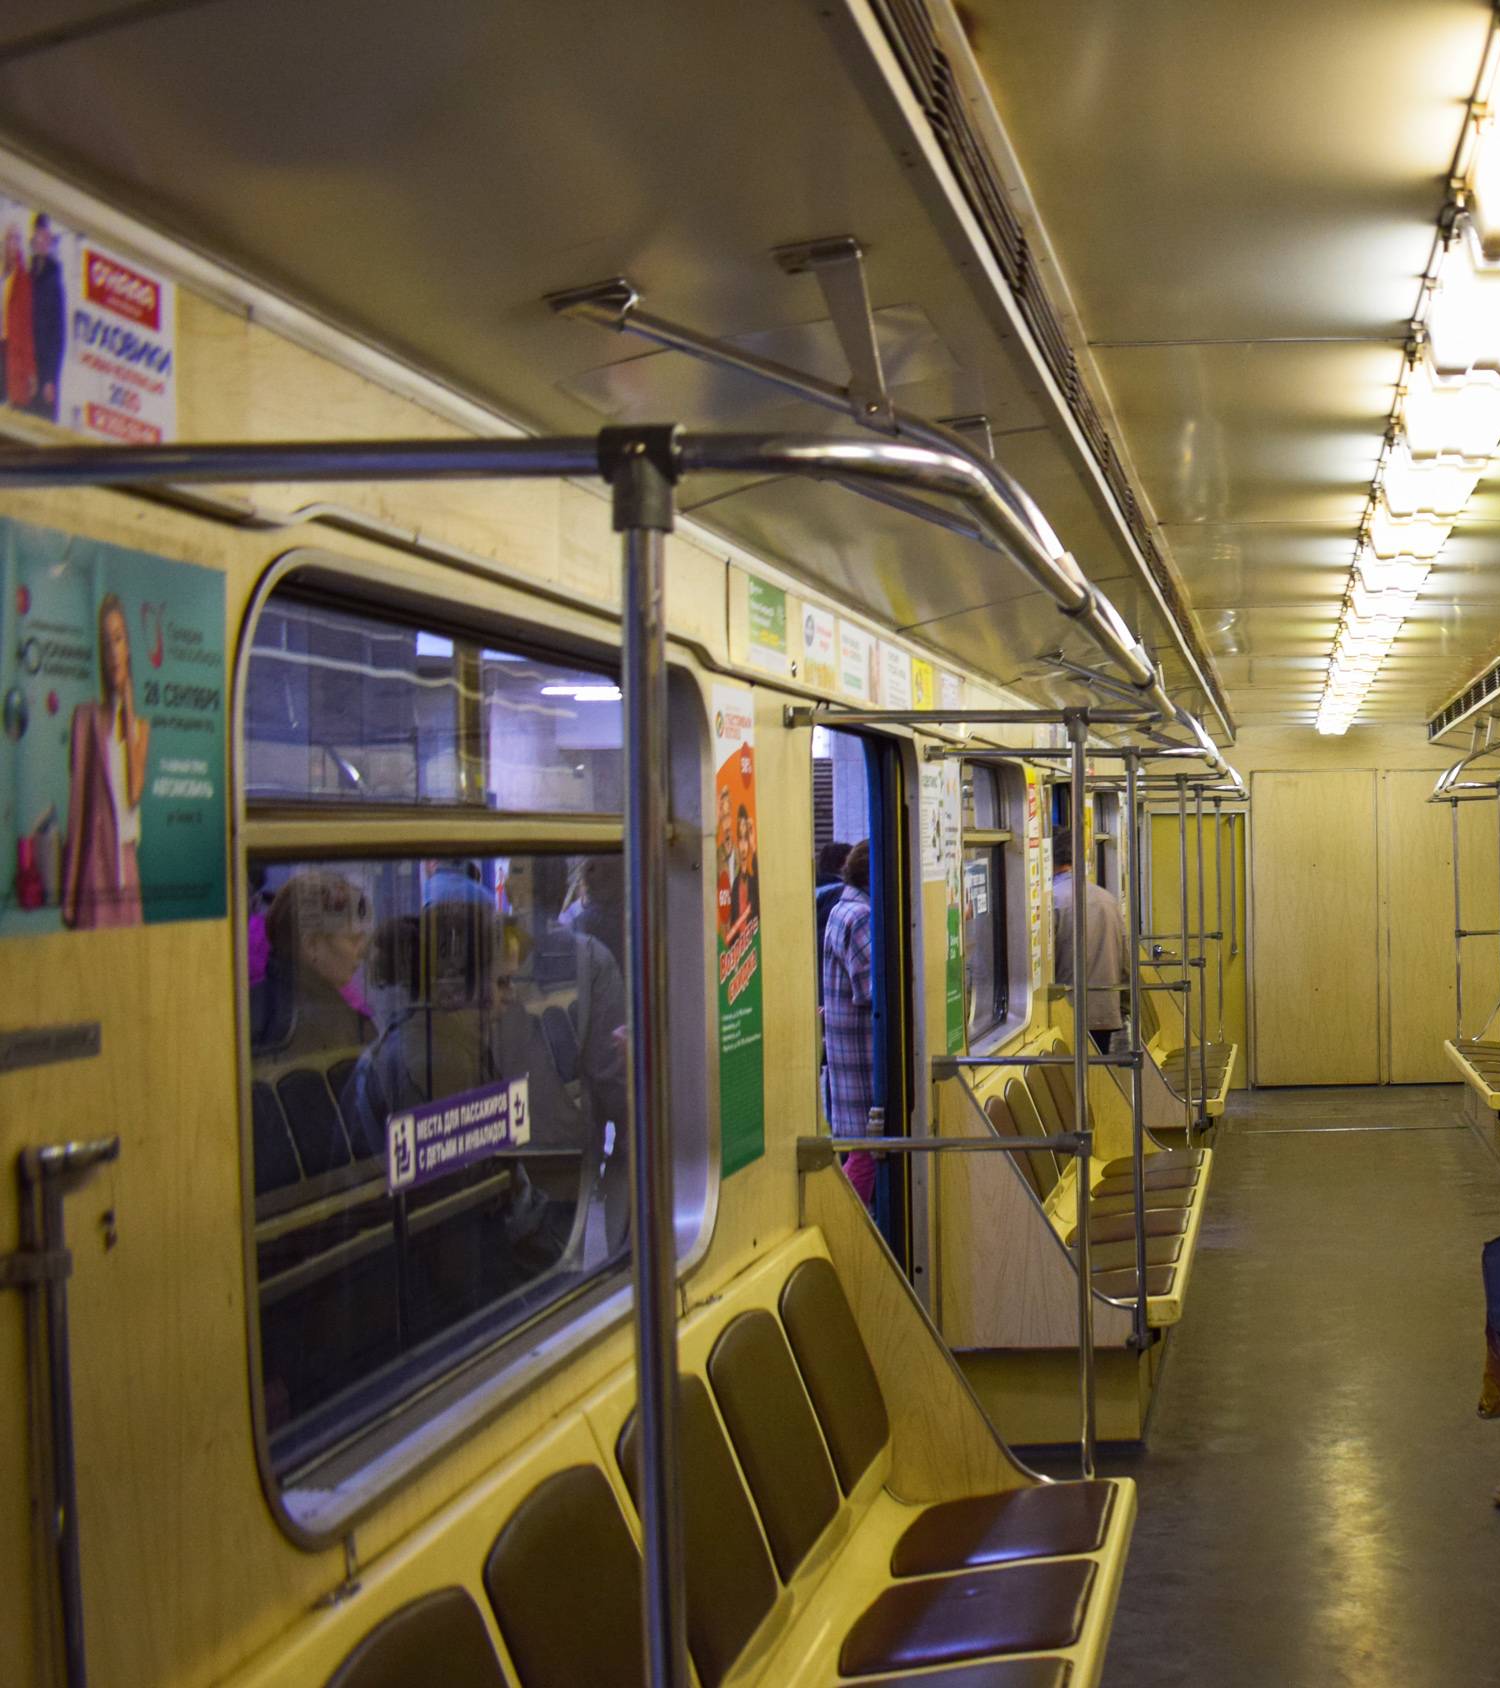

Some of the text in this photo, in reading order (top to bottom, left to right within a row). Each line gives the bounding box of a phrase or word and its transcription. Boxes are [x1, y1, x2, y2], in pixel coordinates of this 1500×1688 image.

[416, 1093, 507, 1142] МЕСТА ДЛЯ ПАССАЖИРОВ
[419, 1118, 507, 1172] С ДЕТЬМИ И ИНВАЛИДОВ
